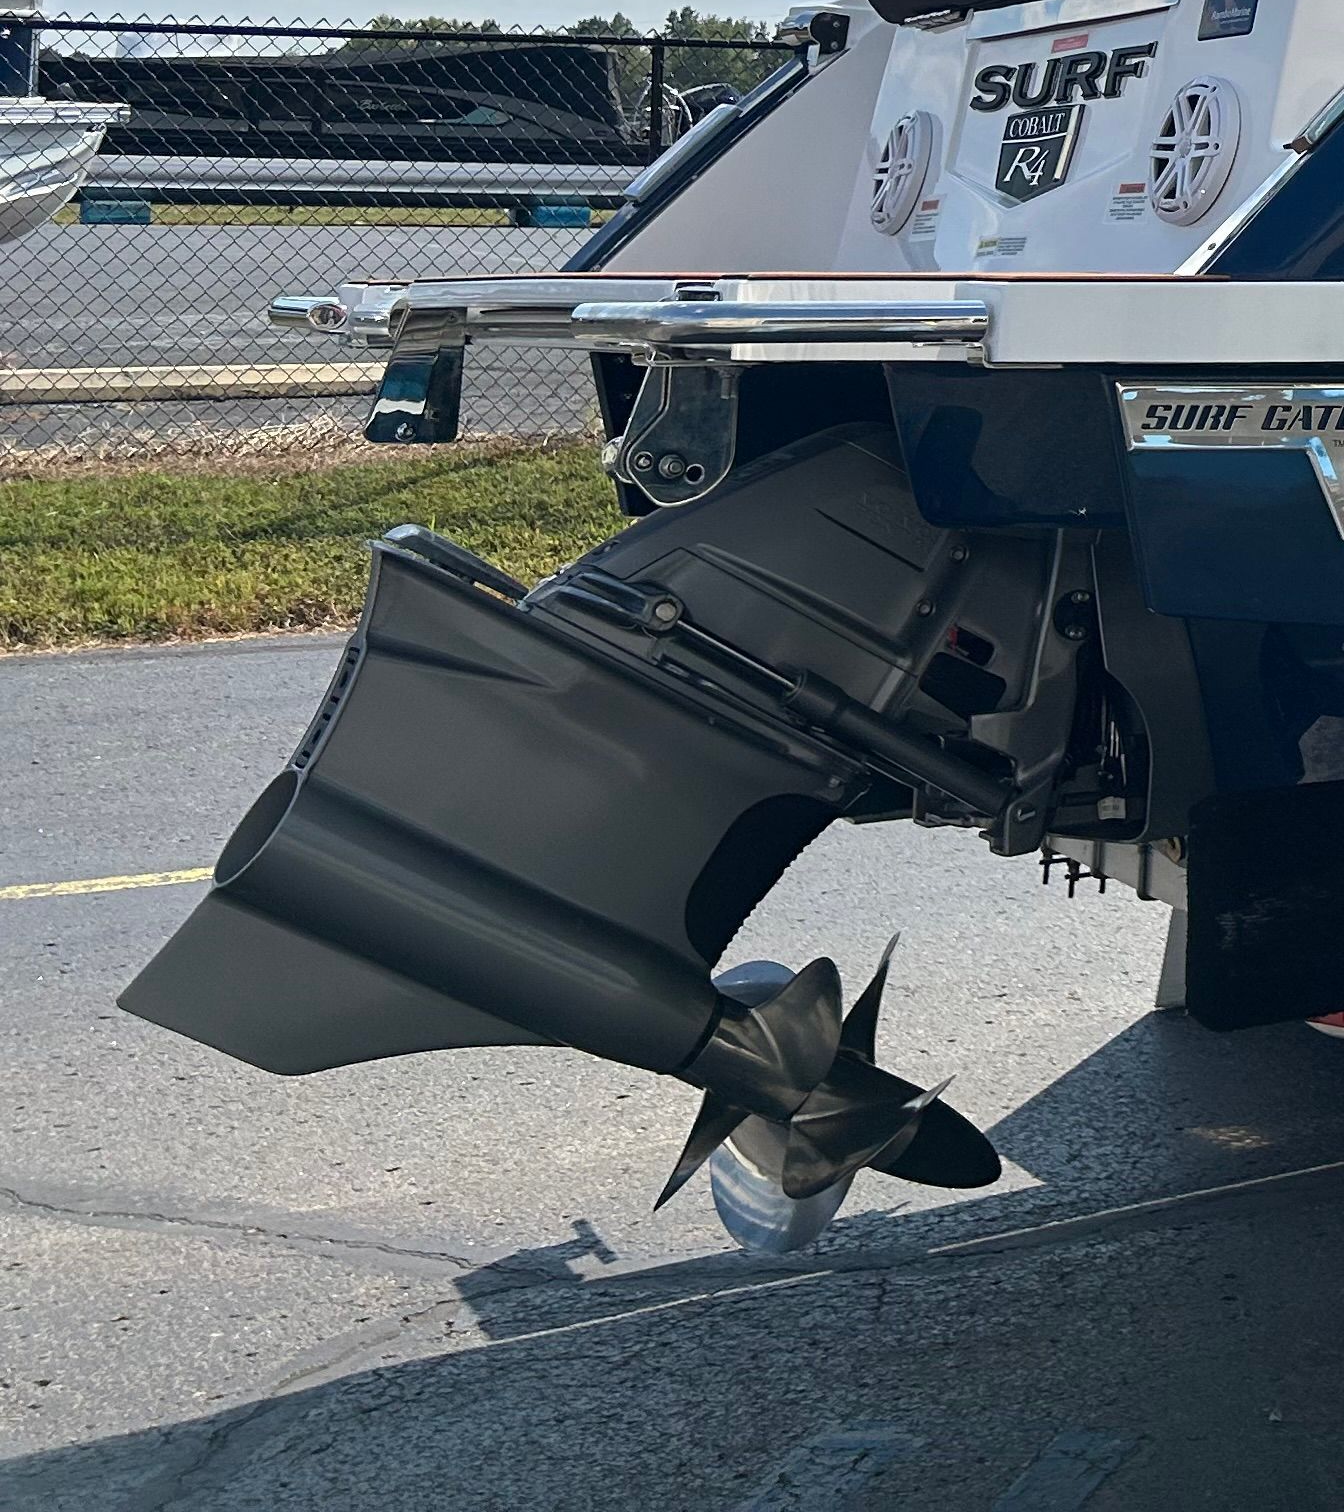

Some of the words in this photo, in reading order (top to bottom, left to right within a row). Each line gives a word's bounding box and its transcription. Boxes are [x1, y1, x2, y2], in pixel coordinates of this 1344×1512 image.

[969, 40, 1159, 112] SURF
[1009, 113, 1067, 139] COBALT
[1003, 145, 1046, 186] R4
[1140, 404, 1254, 431] SURF
